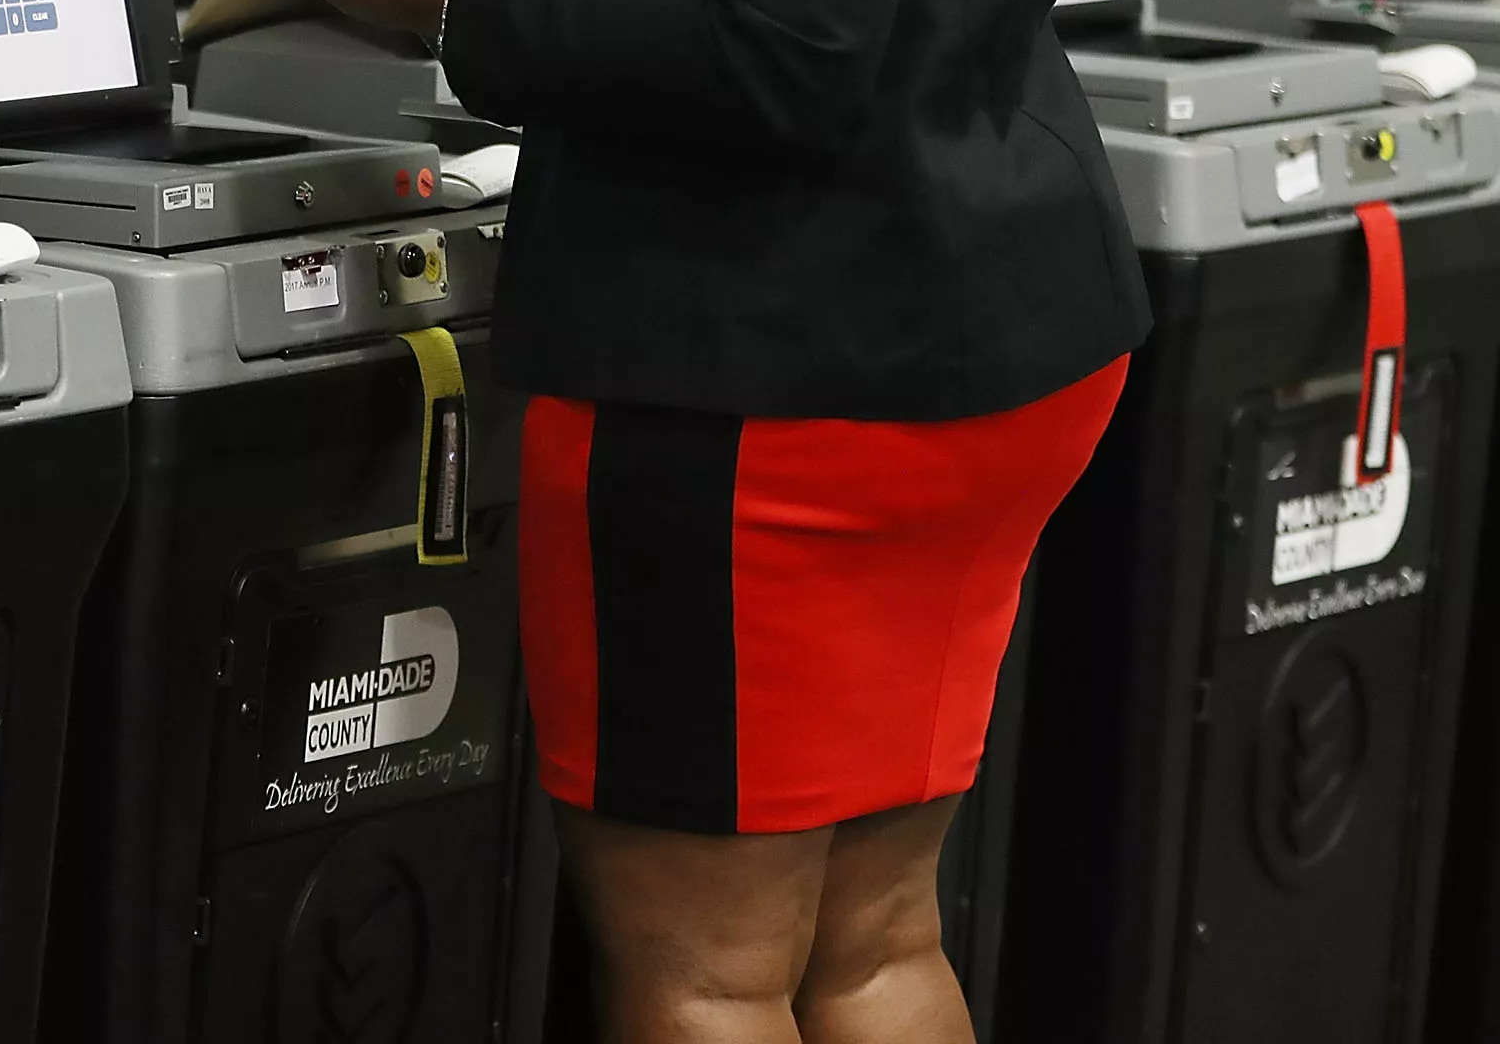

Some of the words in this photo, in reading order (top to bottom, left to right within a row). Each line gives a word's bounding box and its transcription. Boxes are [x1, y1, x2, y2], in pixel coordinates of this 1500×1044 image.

[12, 13, 19, 26] 0
[308, 658, 432, 712] MIAMI-DADE
[308, 713, 371, 753] COUNTY
[265, 772, 341, 814] Delivering
[345, 752, 413, 796] Excellence
[417, 749, 455, 783] Every
[459, 740, 489, 775] Day
